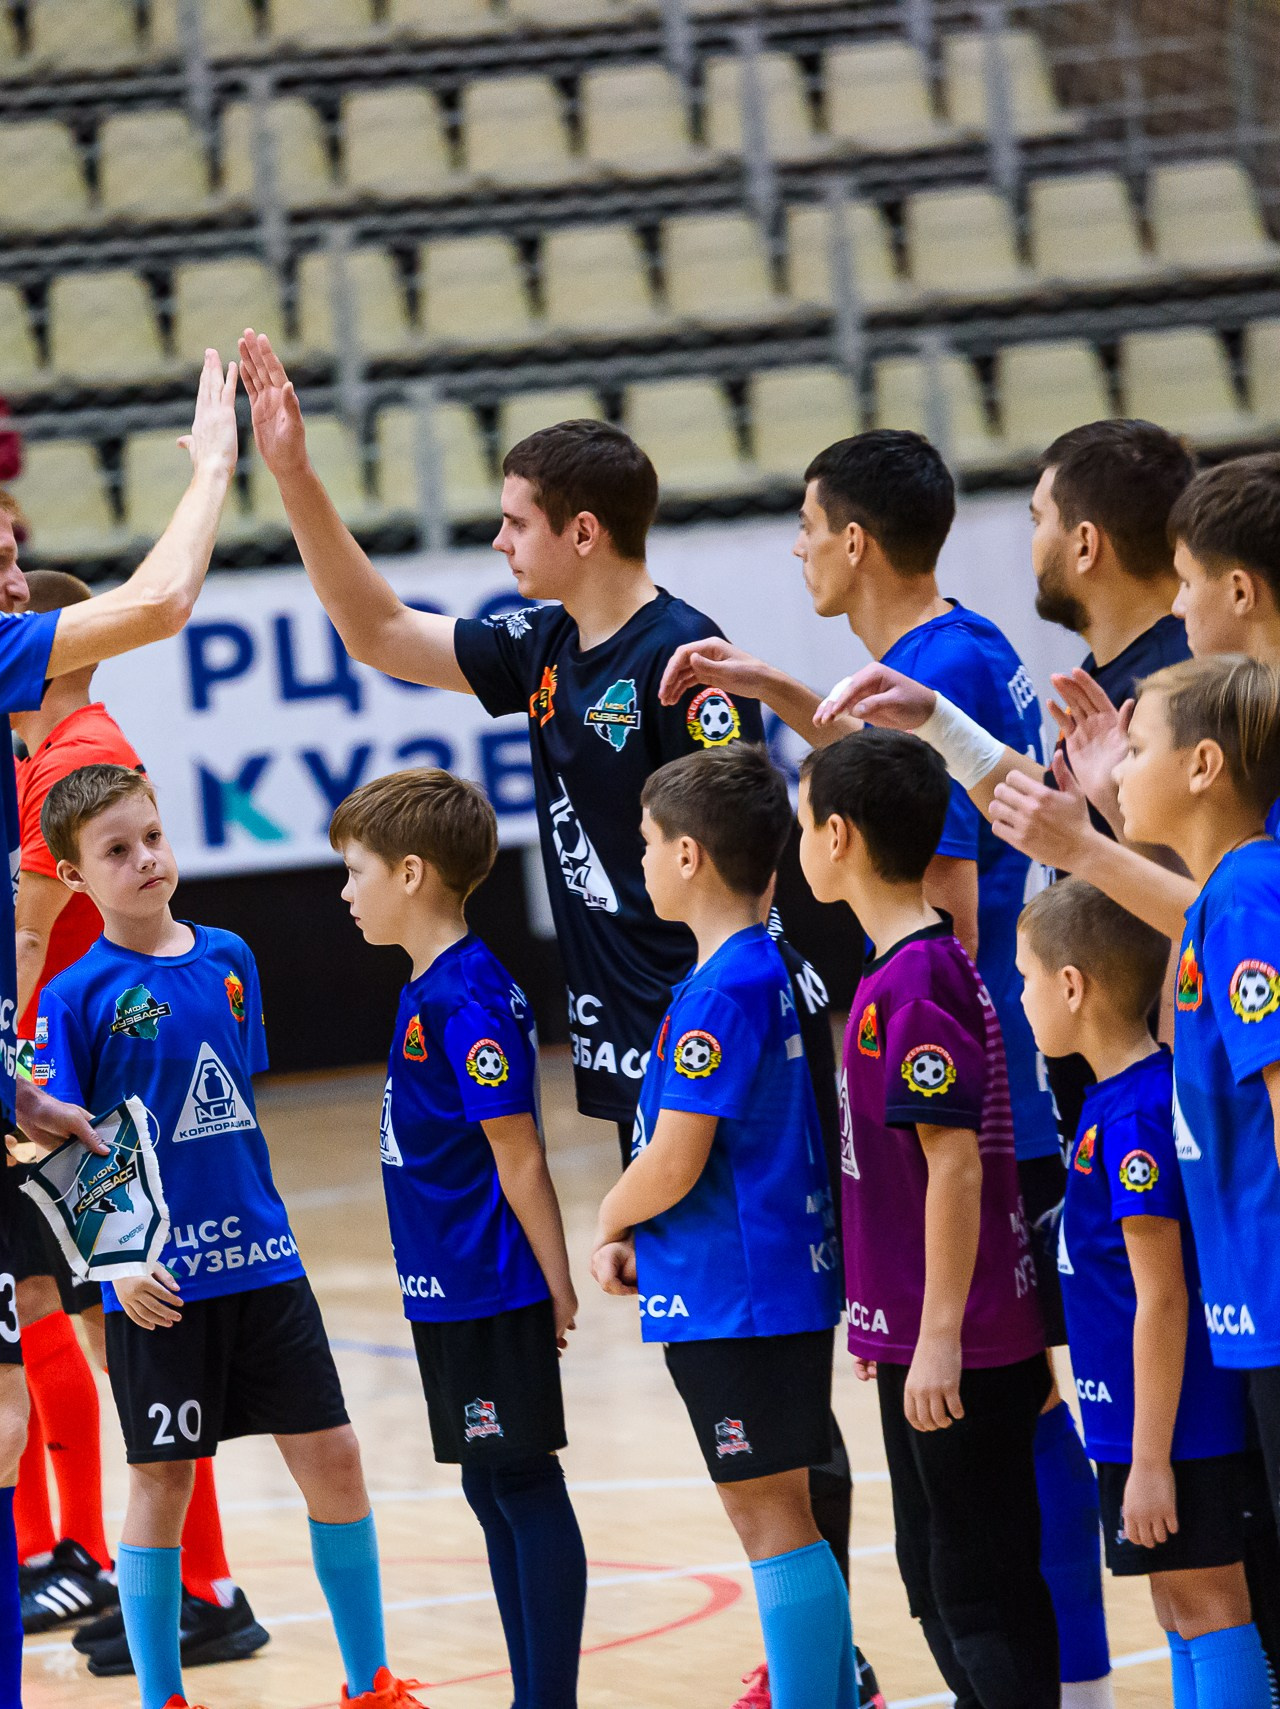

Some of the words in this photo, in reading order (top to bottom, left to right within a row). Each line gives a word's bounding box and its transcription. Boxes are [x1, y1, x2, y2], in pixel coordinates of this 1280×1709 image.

[111, 1006, 167, 1032] КУЗБАСС
[197, 1101, 237, 1123] АСИ
[88, 1162, 116, 1186] МФК
[77, 1166, 134, 1213] КУЗБАСС
[147, 1399, 202, 1446] 20
